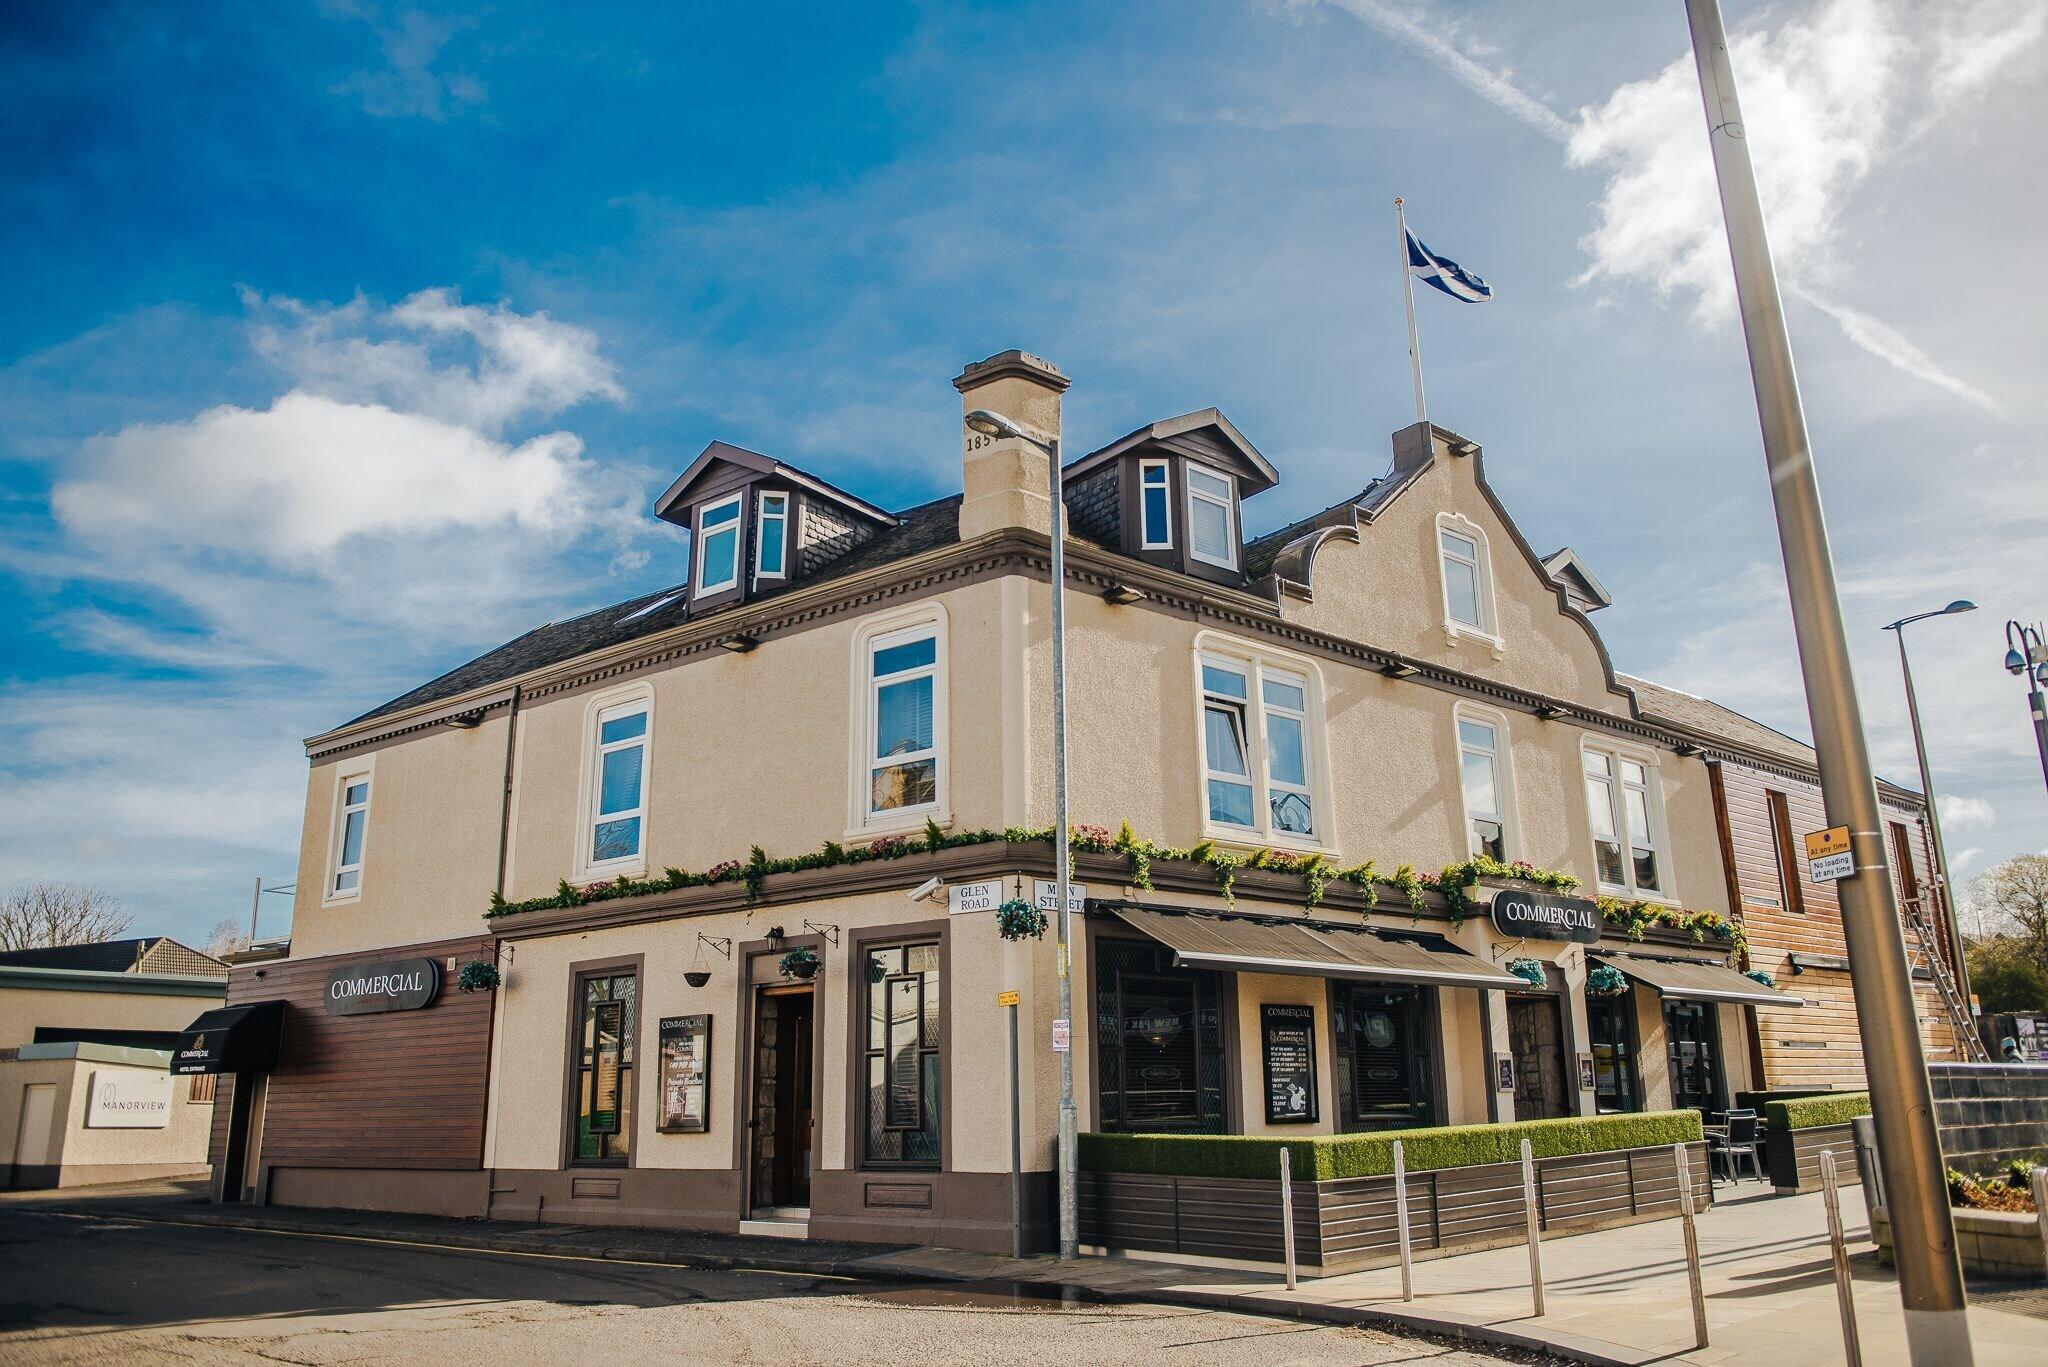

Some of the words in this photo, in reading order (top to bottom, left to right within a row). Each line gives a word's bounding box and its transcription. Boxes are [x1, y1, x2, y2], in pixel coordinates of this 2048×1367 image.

[1833, 842, 1847, 850] time
[1825, 857, 1848, 866] loading
[961, 885, 989, 897] GLEN
[1047, 884, 1075, 896] MN
[961, 898, 989, 910] ROAD
[1506, 902, 1596, 929] COMMERCIAL
[331, 972, 424, 999] COMMERCIAL
[1268, 1008, 1311, 1018] COMMERCIAL
[661, 1019, 704, 1029] COMMERCIAL
[102, 1101, 165, 1110] MANORVIEW
